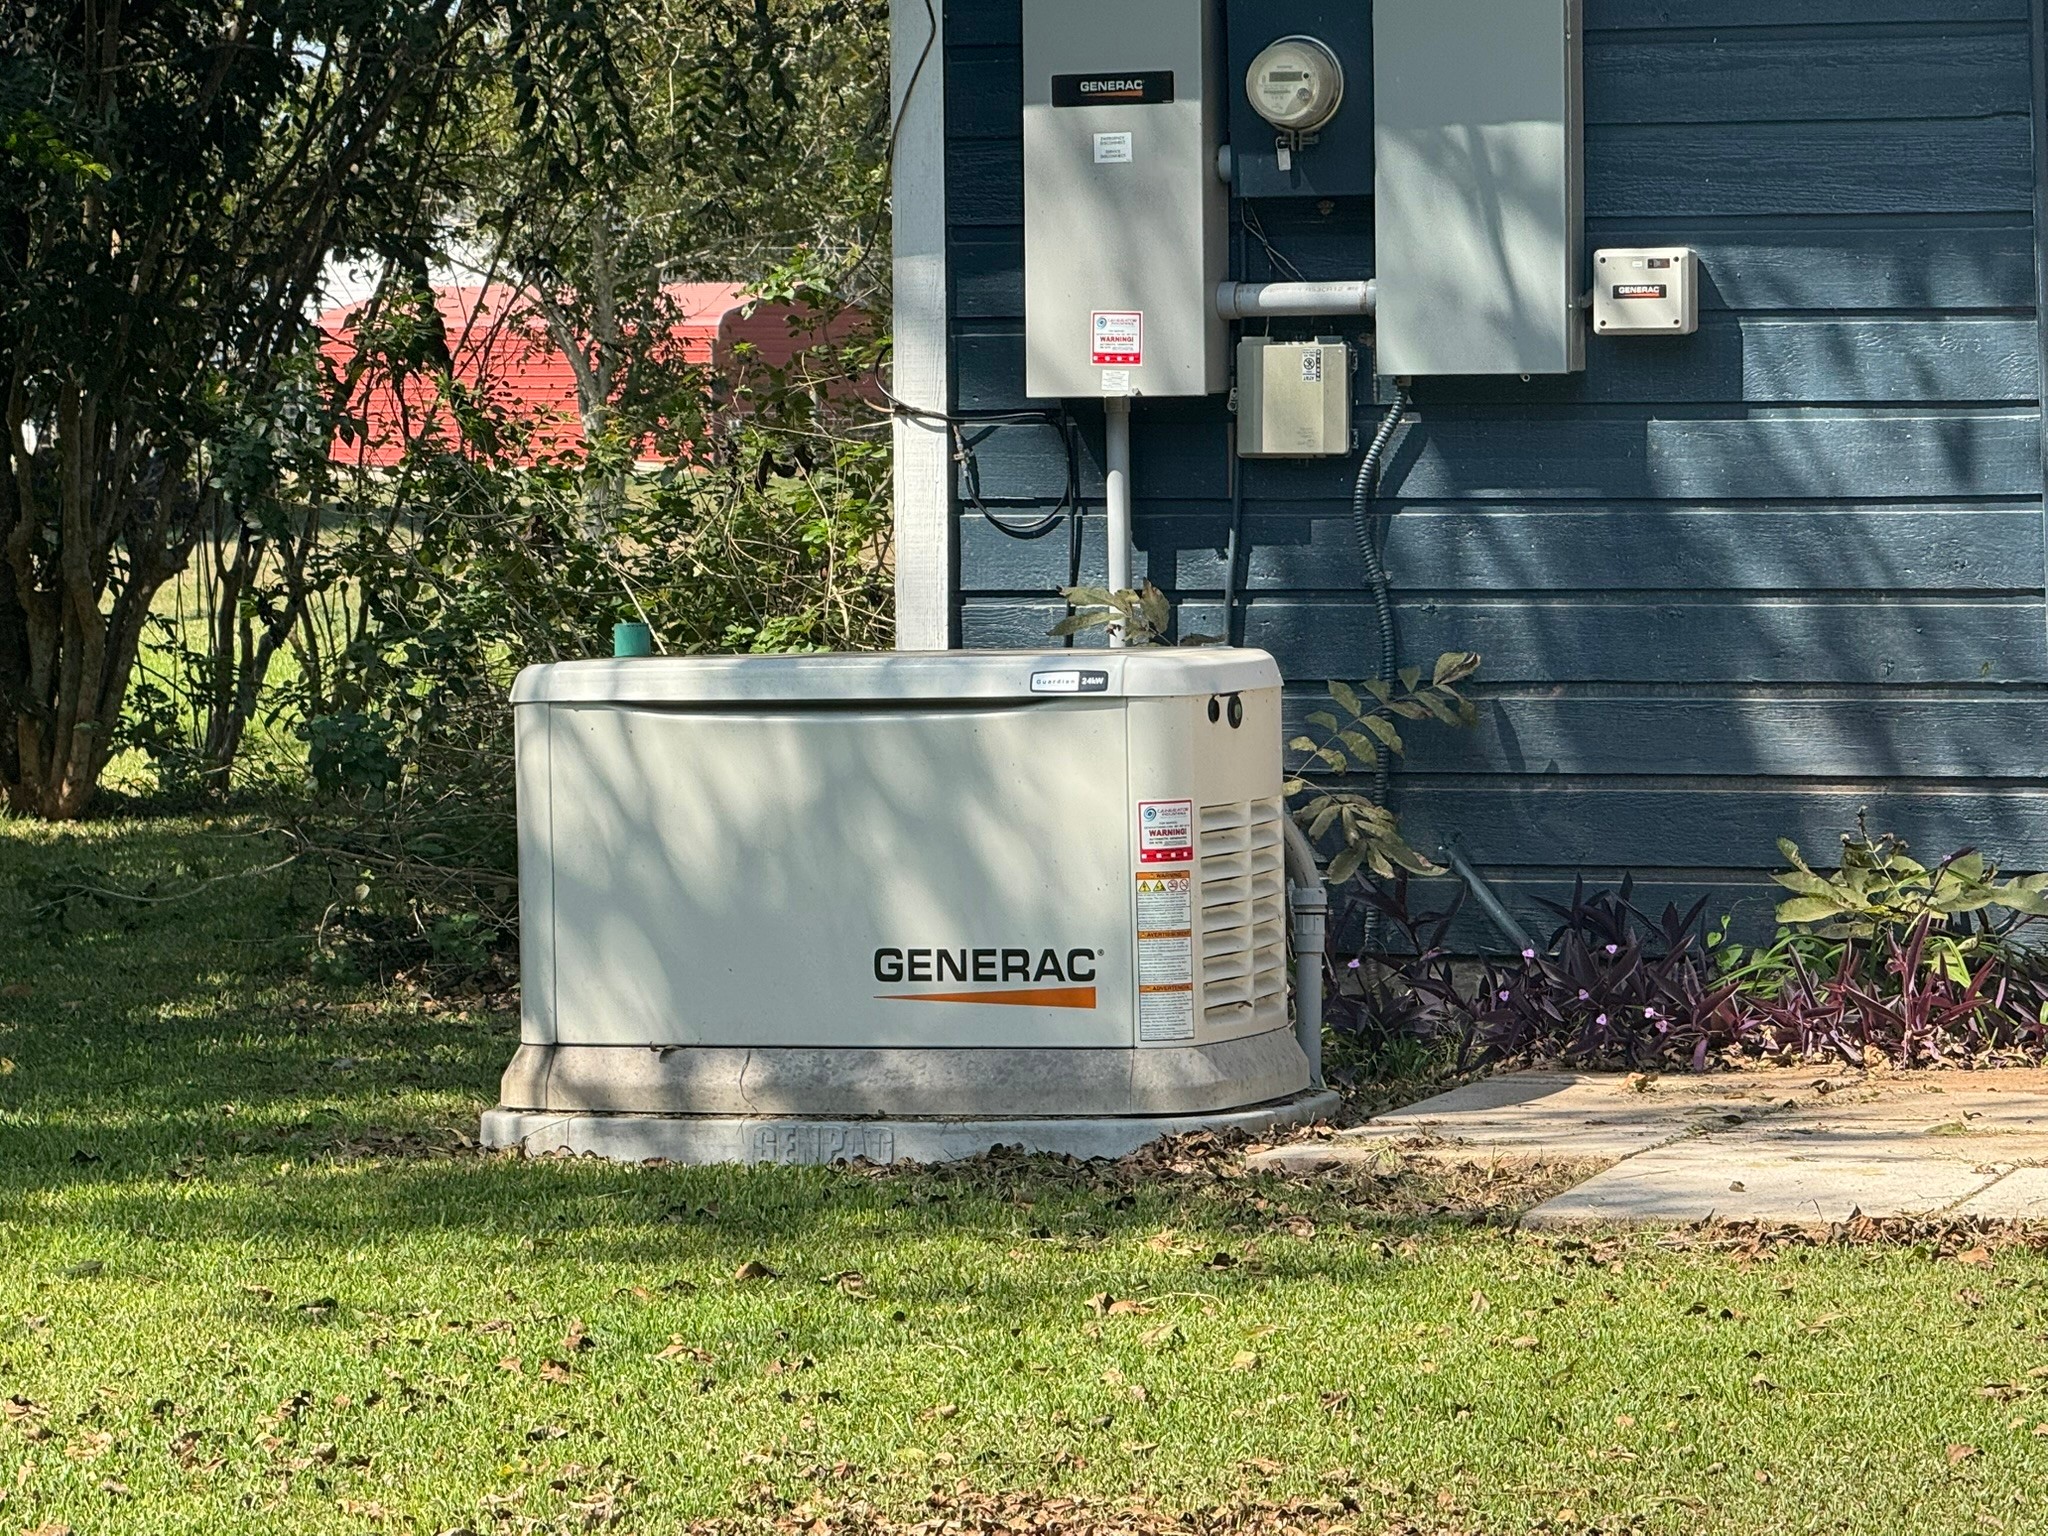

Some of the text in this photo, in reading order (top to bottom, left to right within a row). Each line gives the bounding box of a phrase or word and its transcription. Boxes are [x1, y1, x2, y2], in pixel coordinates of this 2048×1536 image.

[1080, 80, 1143, 92] GENERAC
[1618, 286, 1660, 294] GENERAC
[1081, 677, 1105, 685] 24kW
[1149, 828, 1187, 837] WARNING!
